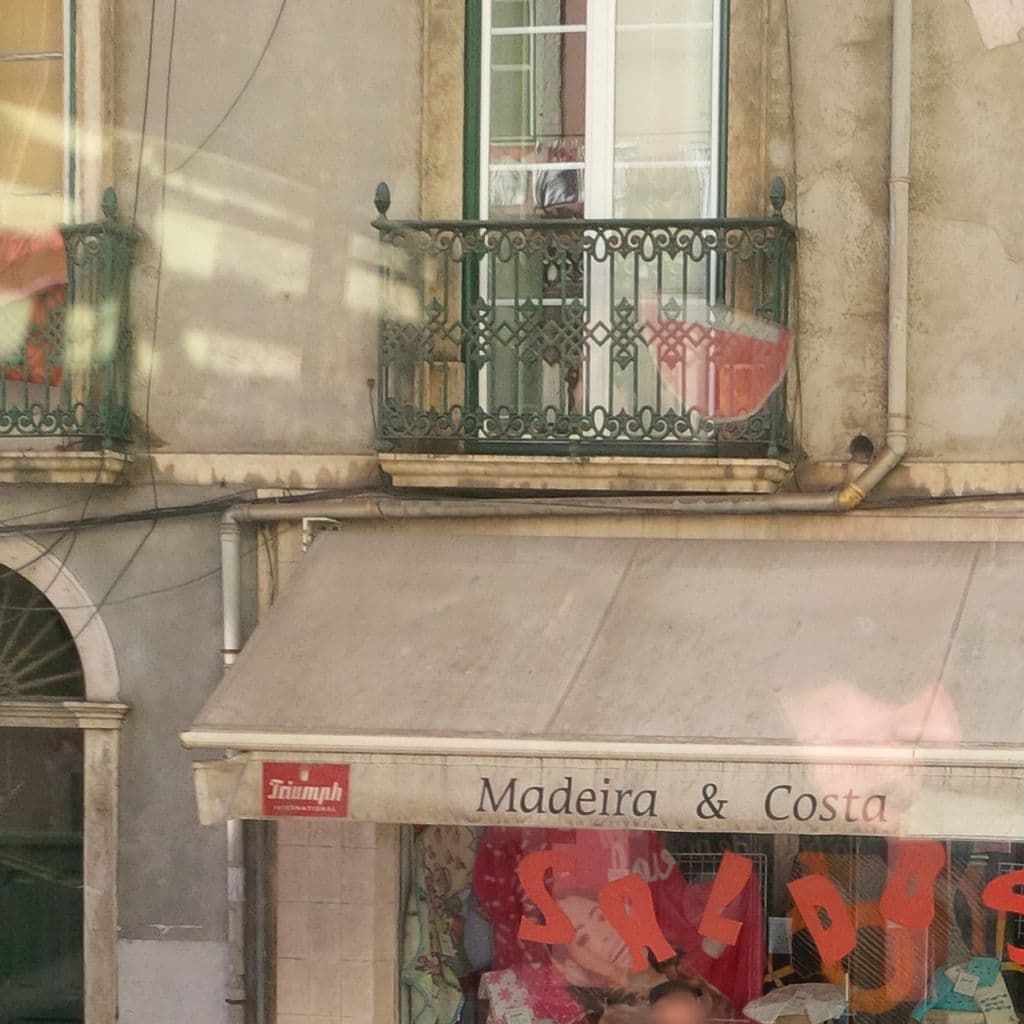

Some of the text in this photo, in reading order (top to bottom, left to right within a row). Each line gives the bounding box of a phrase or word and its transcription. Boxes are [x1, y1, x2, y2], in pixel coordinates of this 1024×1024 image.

[267, 779, 342, 805] Triumph
[476, 777, 888, 822] Madeira & Costa
